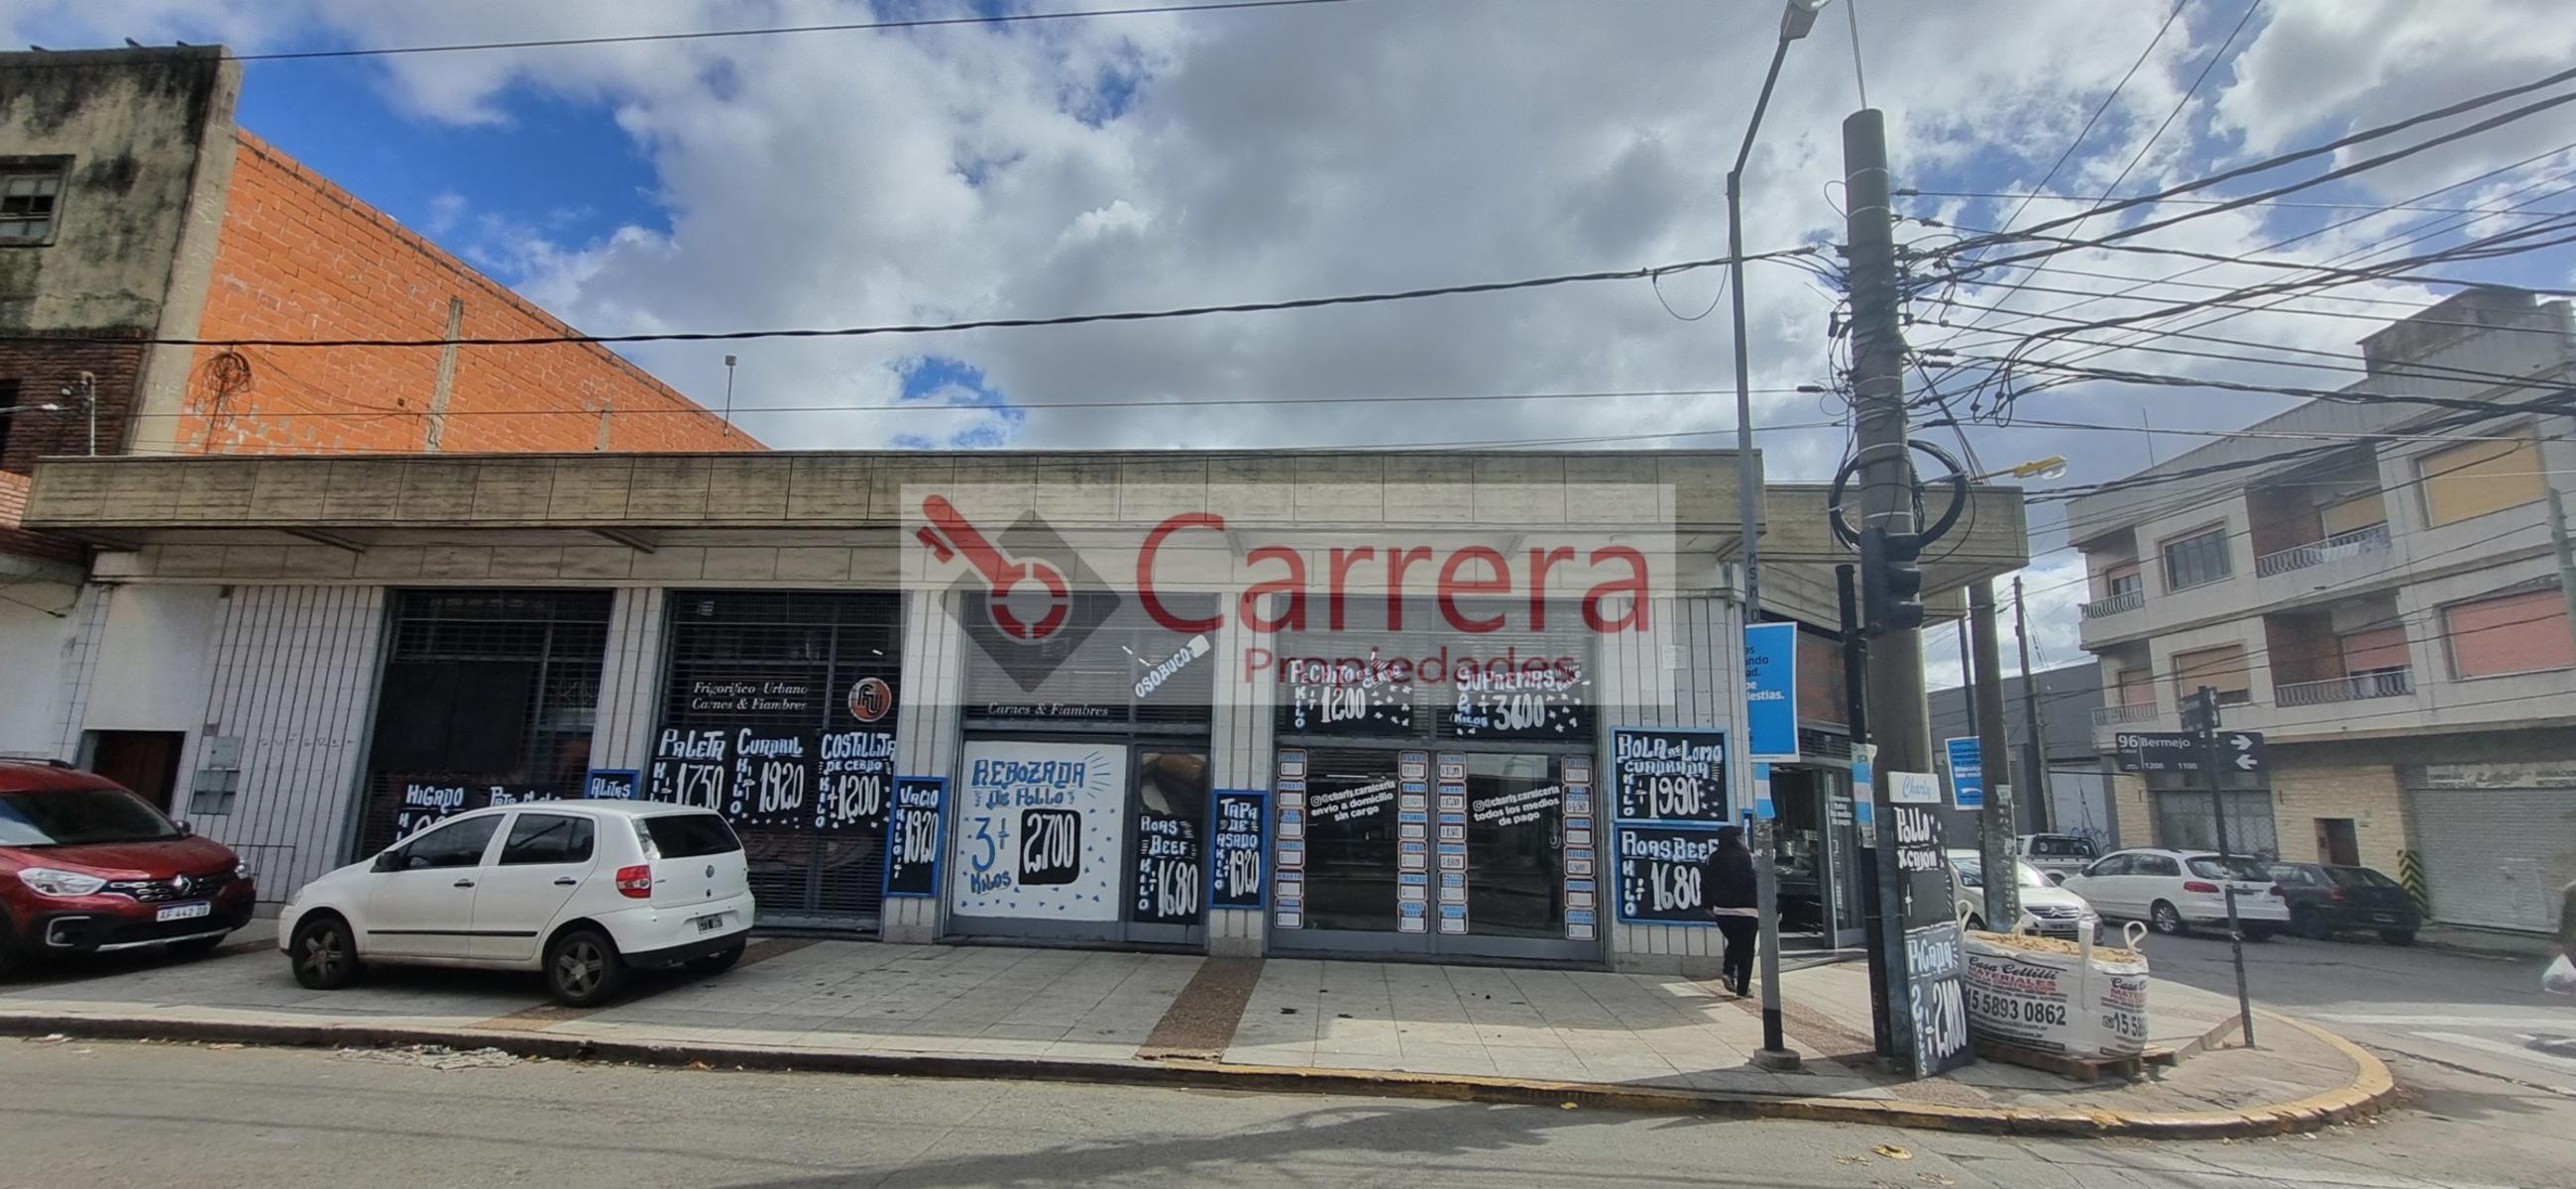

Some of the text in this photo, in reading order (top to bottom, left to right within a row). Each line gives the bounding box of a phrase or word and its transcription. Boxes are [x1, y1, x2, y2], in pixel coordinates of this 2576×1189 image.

[763, 682, 809, 695] Urbano
[1135, 646, 1190, 698] OSOBUCO
[691, 698, 733, 710] Carnes
[751, 698, 808, 710] Fiambres
[1320, 686, 1366, 723] 1200
[2117, 734, 2190, 750] 96 Bermejo
[758, 761, 804, 813] 1920
[971, 758, 1086, 790] REBOZADA
[838, 774, 880, 820] 1200
[1015, 789, 1064, 807] POLLO
[1333, 805, 1380, 822] sin cargo
[1340, 802, 1349, 811] a
[1349, 791, 1395, 808] domicilio
[1473, 797, 1560, 821] todos los medios
[1649, 776, 1700, 818] 1990
[1498, 811, 1540, 826] de pago
[1893, 807, 1931, 844] POLLO
[903, 810, 940, 865] 1920
[971, 816, 996, 873] 3
[1022, 812, 1075, 874] 2700
[1149, 834, 1188, 856] BEEF
[1216, 832, 1259, 851] ASADO
[1158, 859, 1198, 918] 1680
[1229, 848, 1260, 899] 1920
[1650, 861, 1702, 912] 1680
[1966, 987, 1979, 1011] 15
[1982, 993, 2019, 1022] 5893
[2024, 1001, 2067, 1027] 0862
[2114, 1011, 2129, 1035] 15
